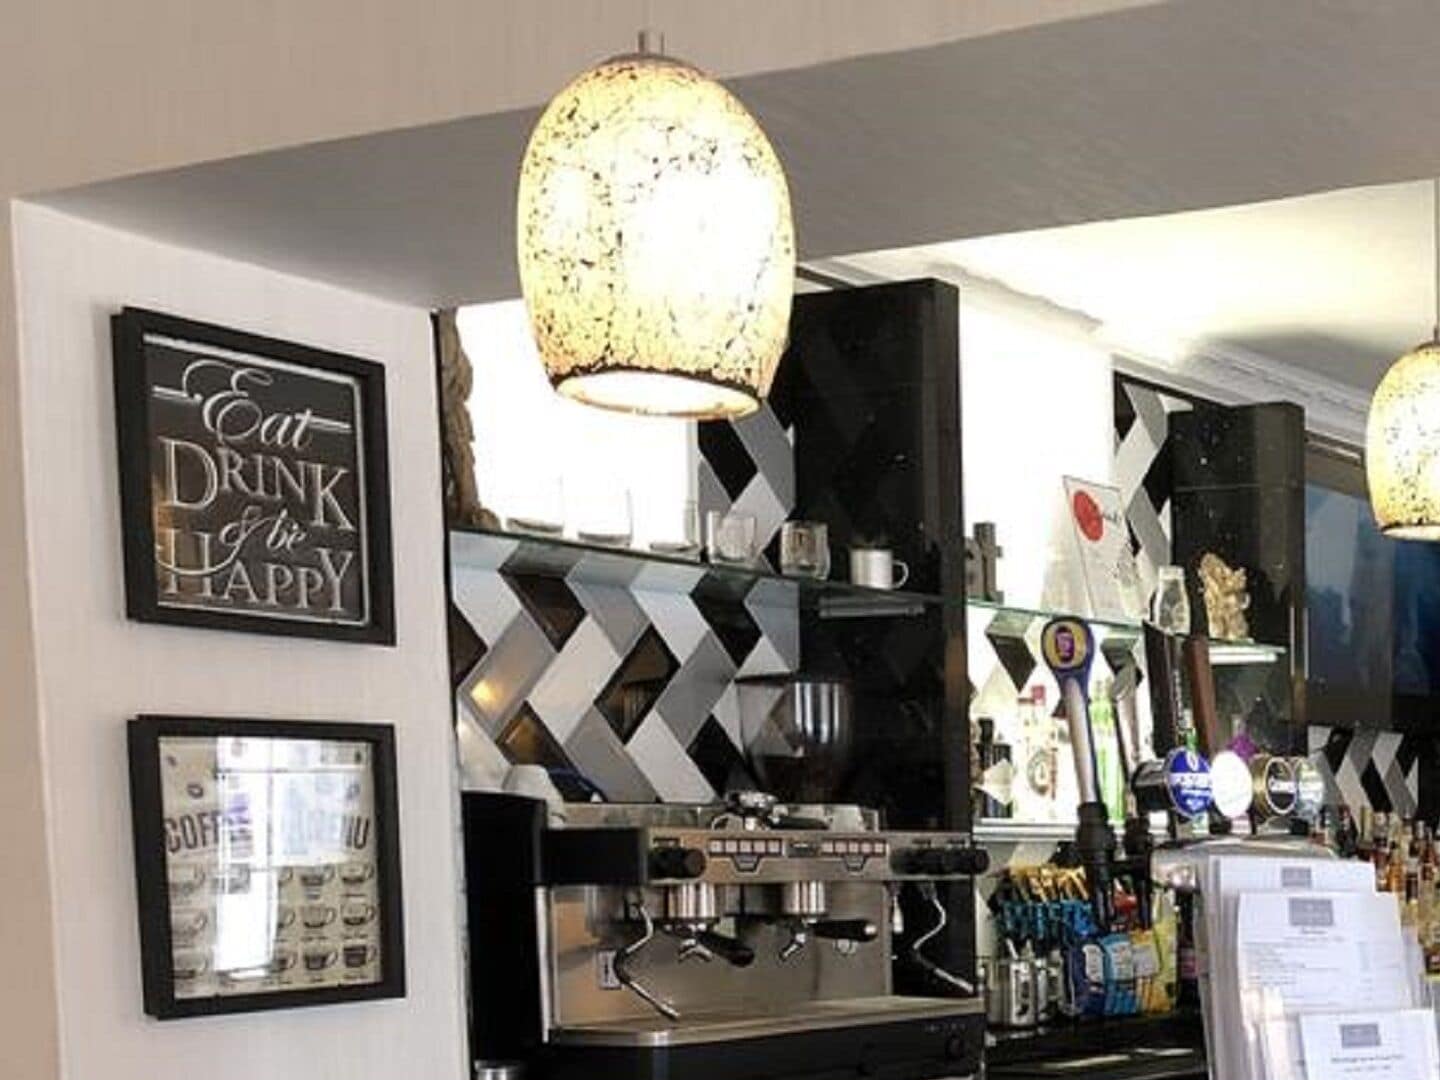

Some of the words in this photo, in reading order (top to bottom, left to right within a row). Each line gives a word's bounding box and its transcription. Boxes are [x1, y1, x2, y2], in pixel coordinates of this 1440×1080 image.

[182, 358, 315, 450] Eat
[157, 435, 356, 532] DRINK
[161, 527, 354, 612] HAPPY
[265, 508, 308, 550] be
[163, 809, 238, 853] COFF
